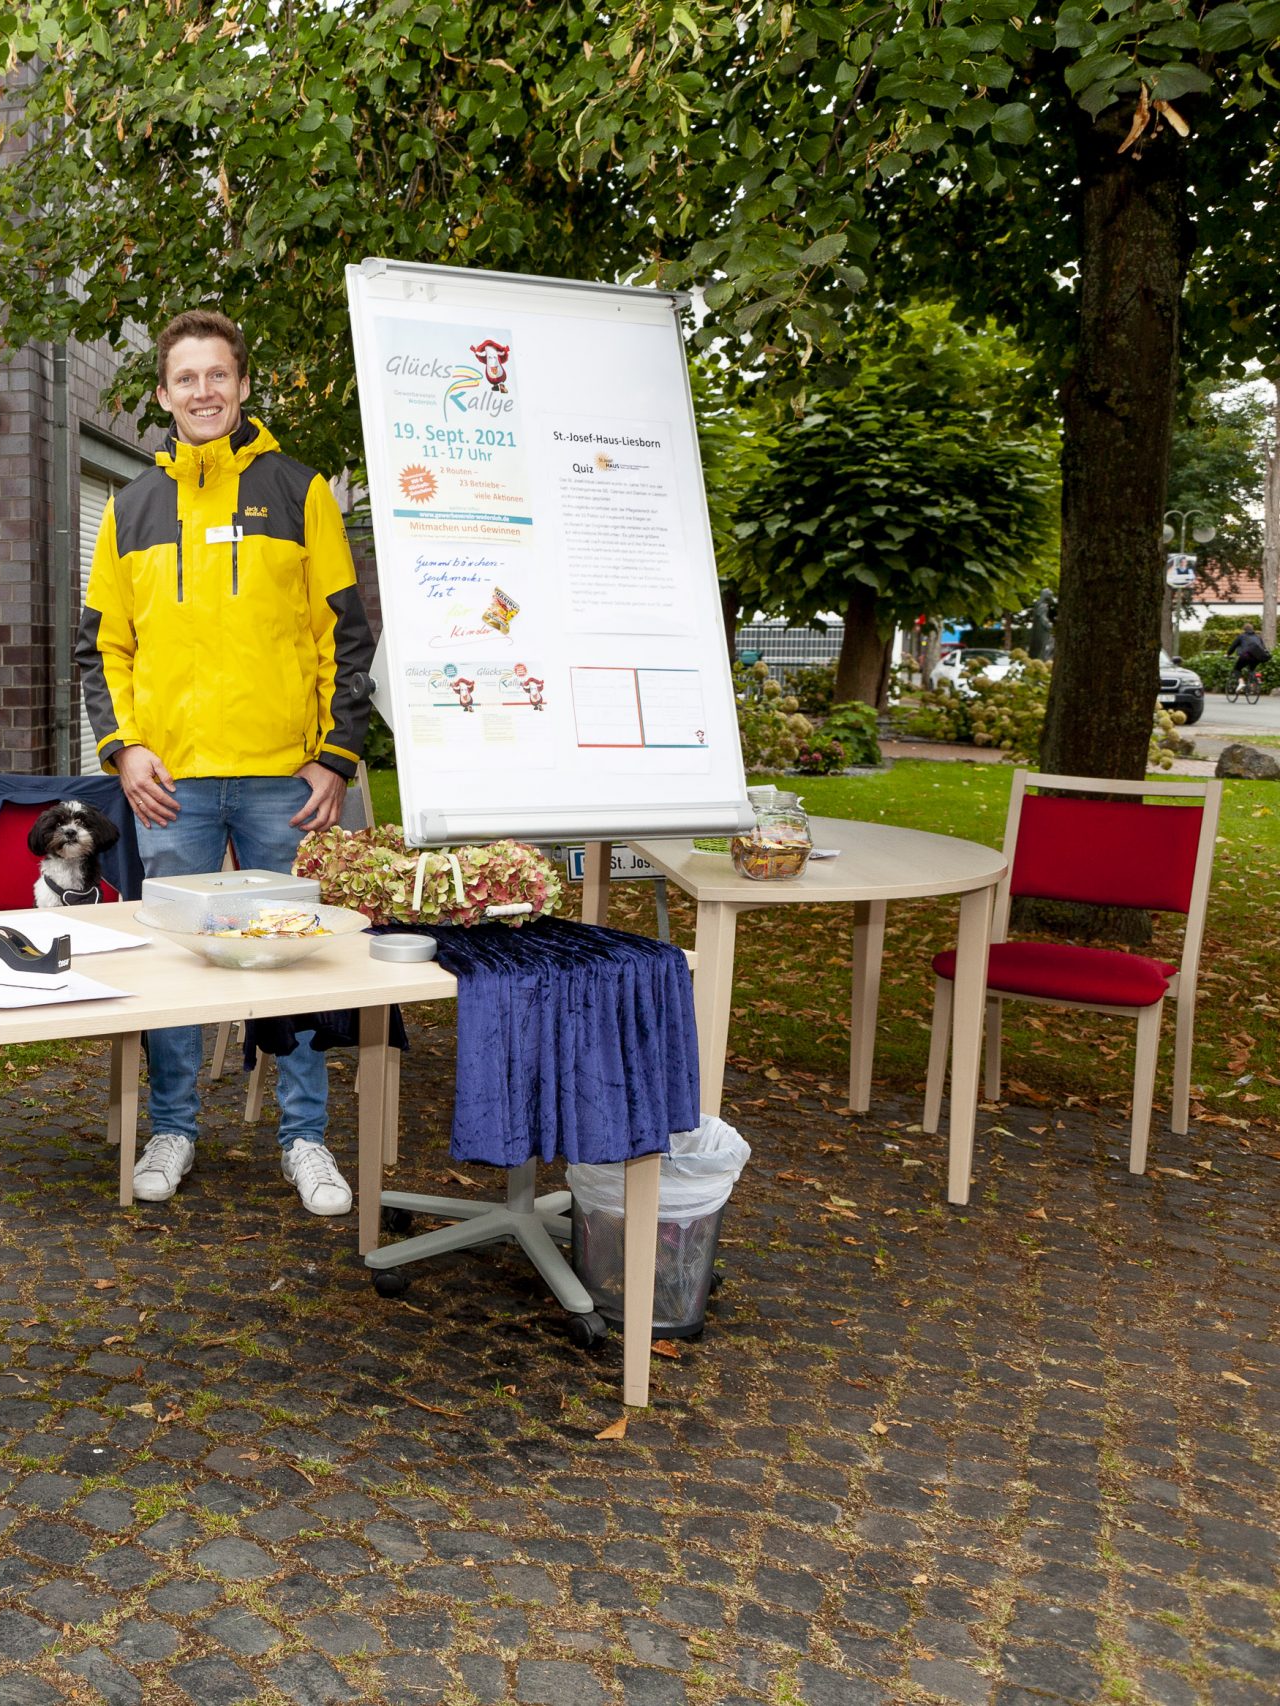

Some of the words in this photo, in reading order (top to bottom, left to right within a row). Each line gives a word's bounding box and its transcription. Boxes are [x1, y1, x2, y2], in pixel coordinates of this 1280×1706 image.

[385, 354, 453, 379] Glücks
[394, 422, 420, 440] 19.
[424, 424, 470, 446] Sept.
[474, 428, 517, 448] 2021
[467, 447, 493, 462] Uhr
[439, 466, 445, 474] 2
[446, 466, 472, 476] Routen
[572, 462, 595, 475] Quiz
[459, 479, 469, 488] 23
[469, 480, 500, 490] Betriebe
[474, 492, 492, 501] viele
[493, 493, 524, 503] Aktionen
[409, 521, 460, 532] Mitmachen
[461, 523, 479, 533] und
[480, 524, 521, 537] Gewinnen
[426, 583, 456, 598] Test
[495, 590, 518, 610] HARIBO
[449, 624, 496, 639] Kinder
[405, 666, 432, 678] Glücks
[476, 666, 502, 677] Glücks
